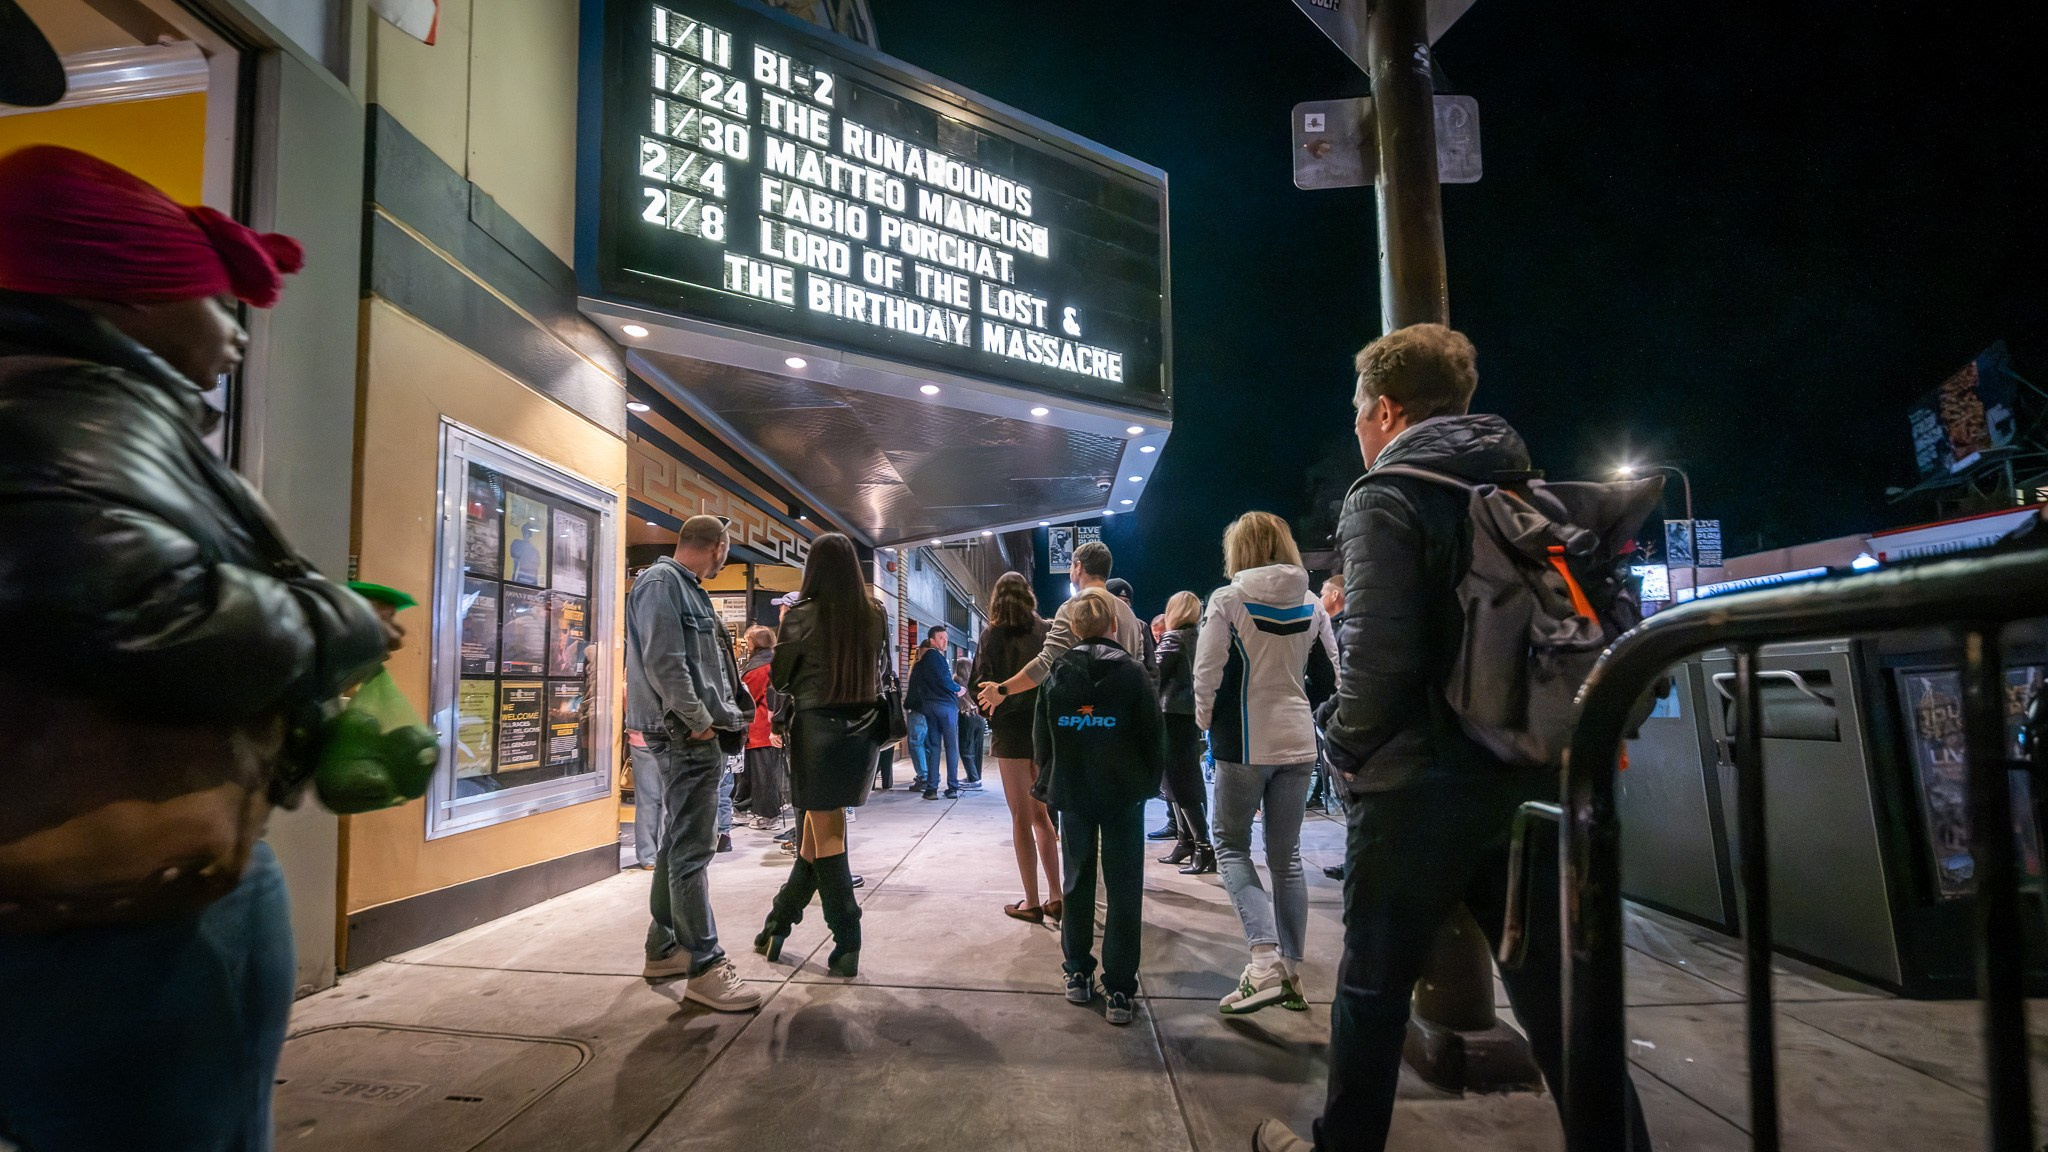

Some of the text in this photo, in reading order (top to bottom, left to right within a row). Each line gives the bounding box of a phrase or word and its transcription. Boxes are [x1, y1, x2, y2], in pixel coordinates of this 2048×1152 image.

[655, 8, 833, 105] 1/11 BI-2
[655, 54, 1032, 217] 1/24 THE RUNAROUNDS
[655, 98, 1049, 258] 1/30 MATTEO MANCUSO
[641, 187, 1081, 336] 2/8 LORD OF THE LOST &
[642, 142, 1013, 283] 2/4 FABIO PORCHAT
[724, 254, 1122, 382] THE BIRTHDAY MASSACRE
[1077, 526, 1100, 534] LIVE
[501, 712, 539, 721] WELCOME
[1057, 714, 1117, 731] SPARC
